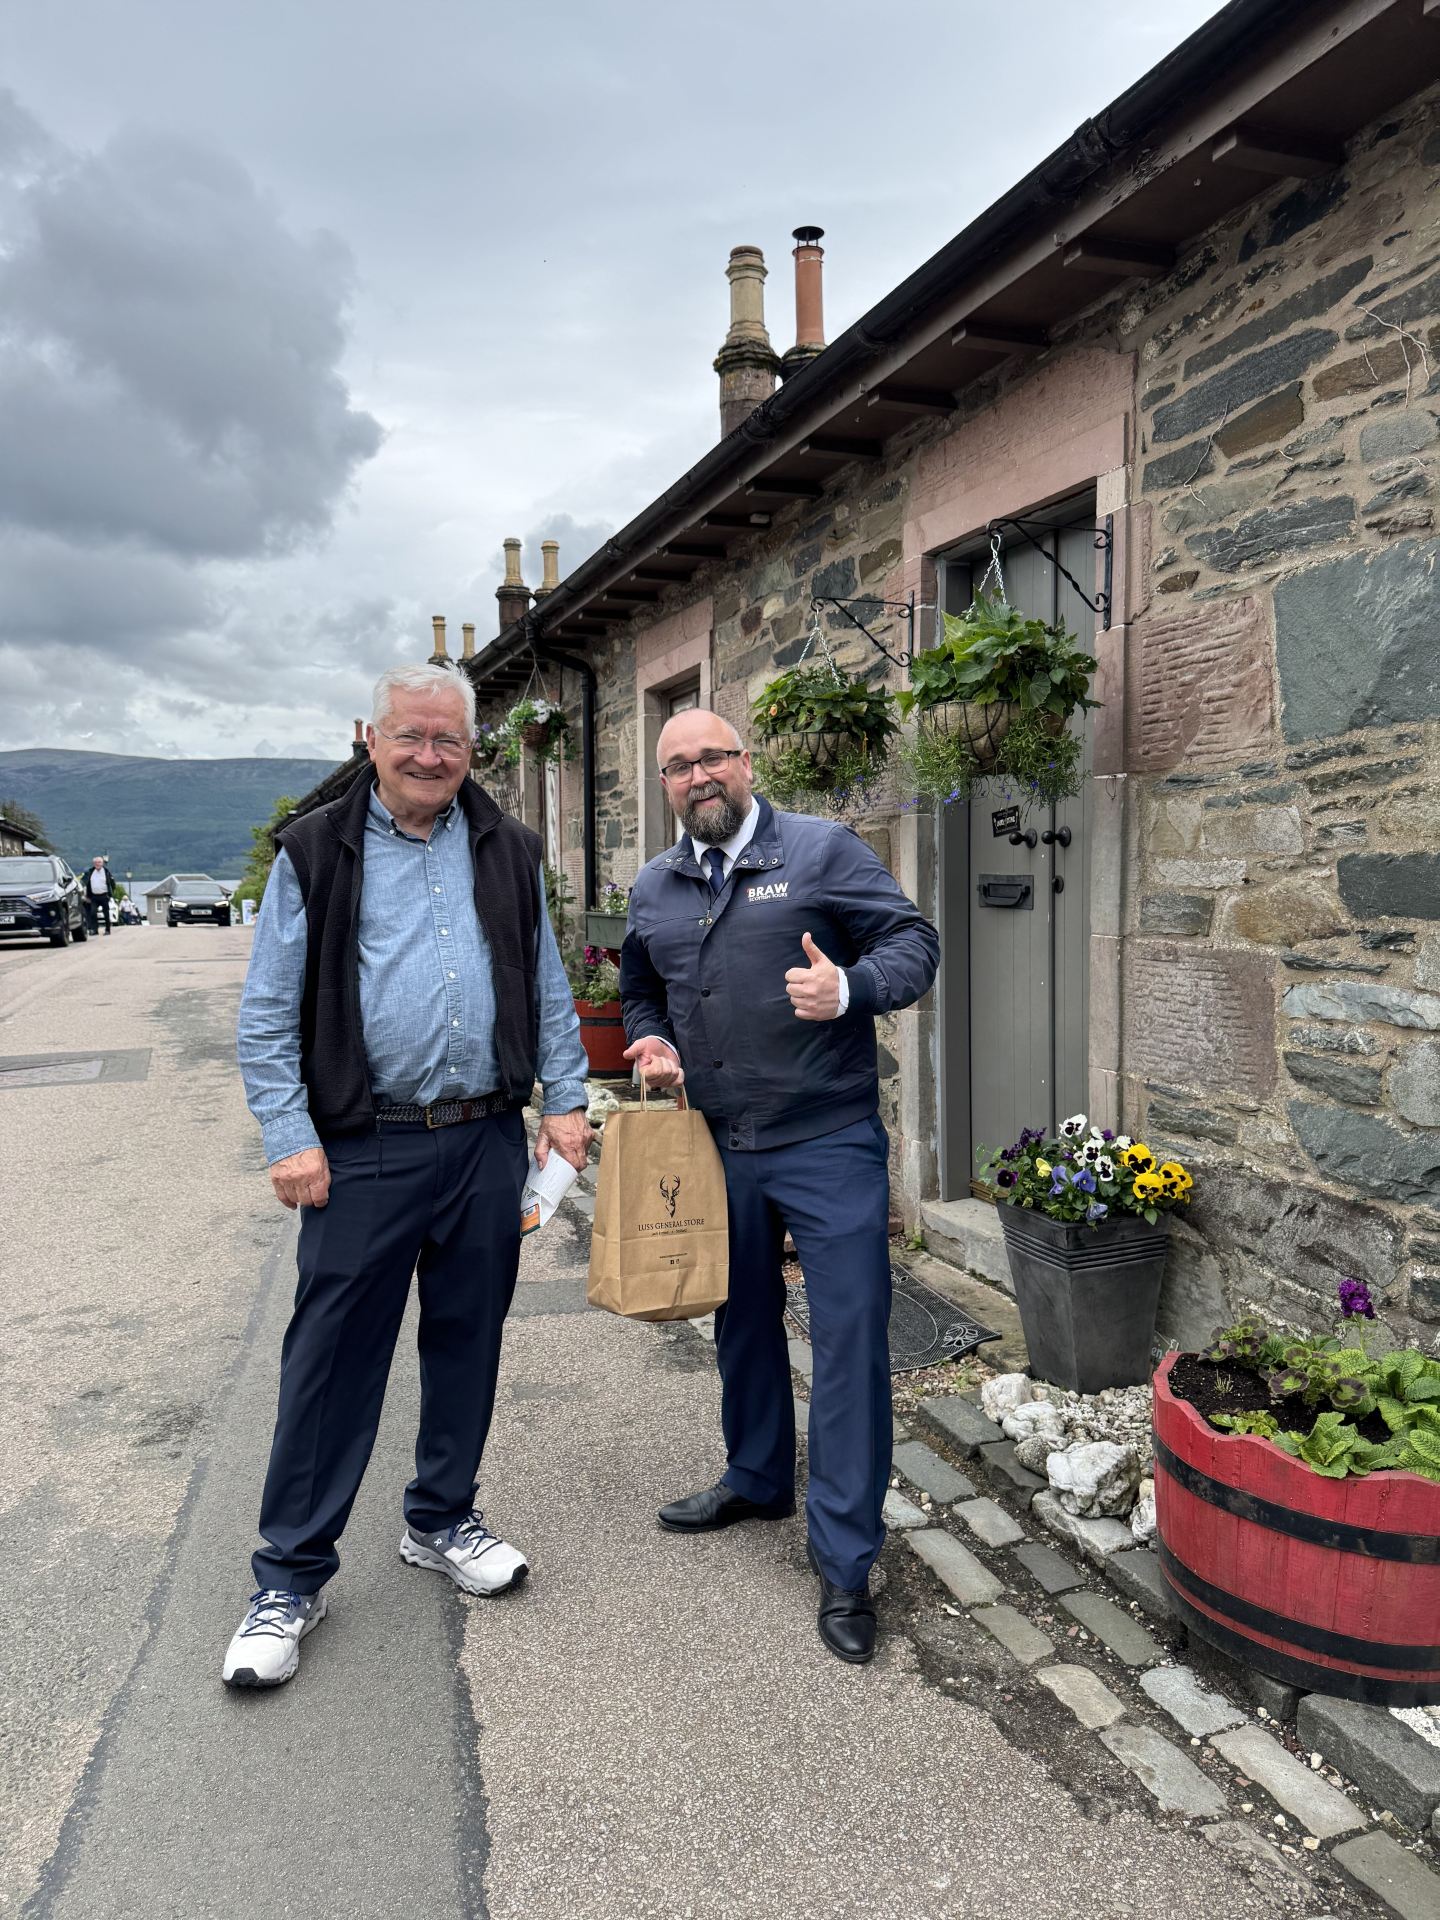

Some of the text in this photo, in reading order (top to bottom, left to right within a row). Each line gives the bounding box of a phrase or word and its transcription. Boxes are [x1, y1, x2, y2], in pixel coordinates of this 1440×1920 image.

[748, 882, 789, 898] BRAW
[638, 1223, 654, 1232] LUSS
[654, 1220, 683, 1230] GENERAL
[683, 1218, 705, 1227] STORE
